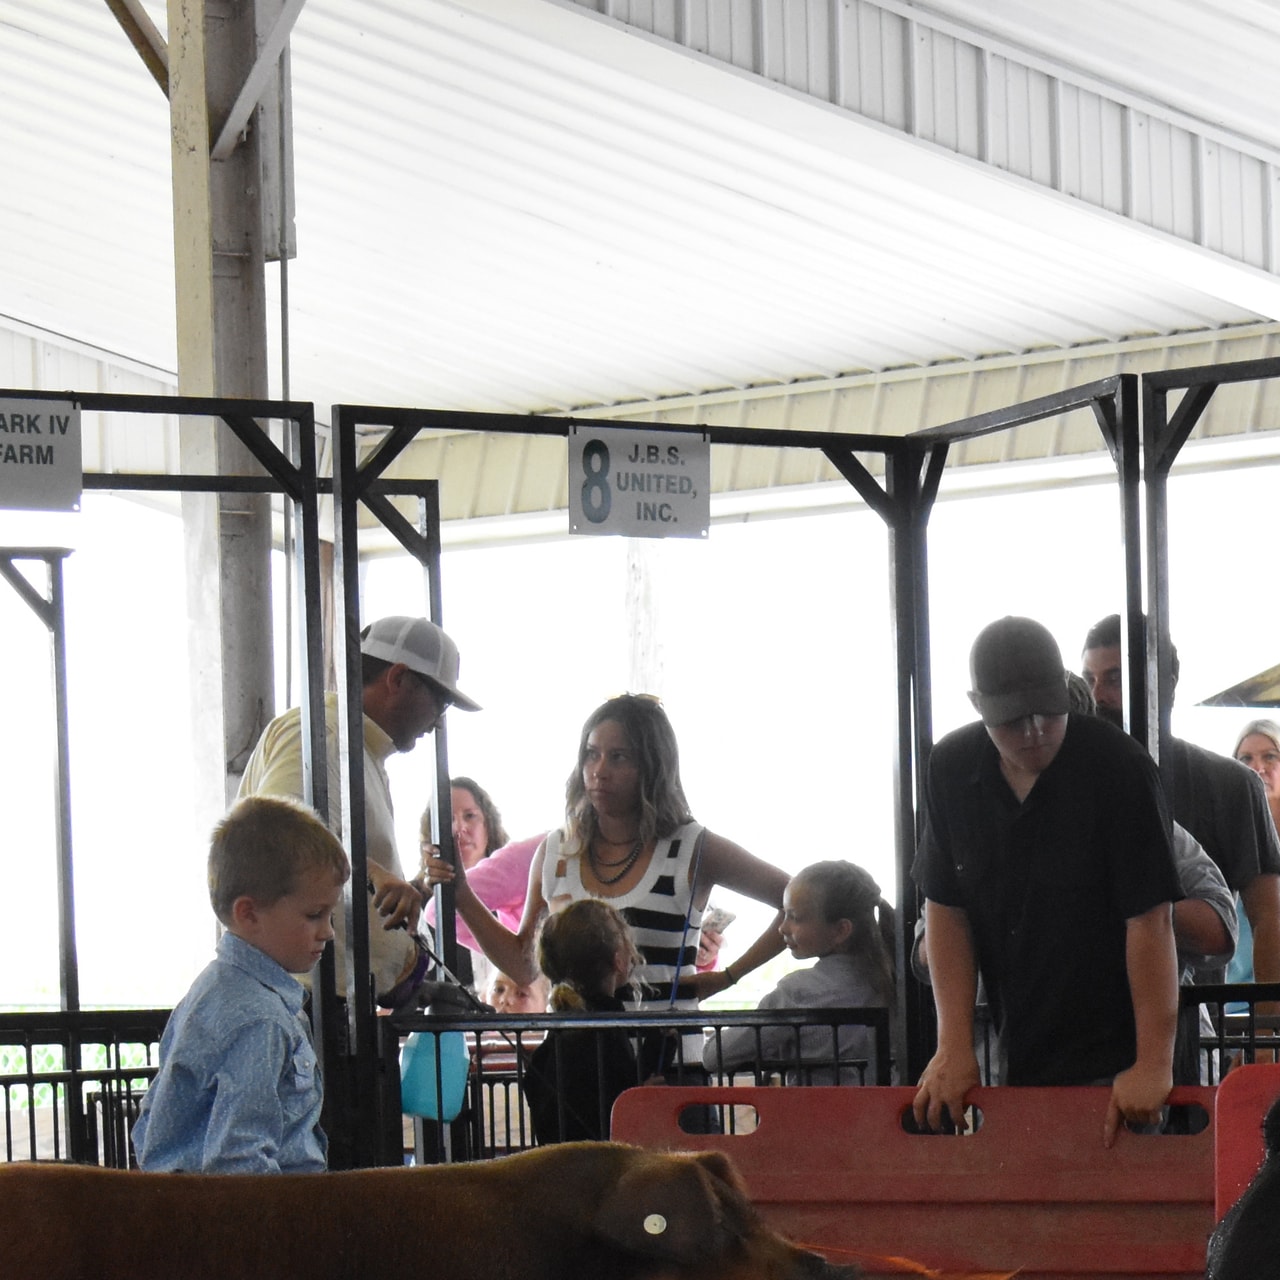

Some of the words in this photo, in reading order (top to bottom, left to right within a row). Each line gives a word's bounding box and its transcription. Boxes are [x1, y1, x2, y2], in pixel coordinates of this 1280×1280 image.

[50, 415, 70, 435] IV
[0, 444, 54, 465] ARM
[628, 444, 685, 466] J.B.S.
[581, 439, 612, 524] 8
[616, 472, 697, 499] UNITED,
[636, 502, 678, 523] INC.
